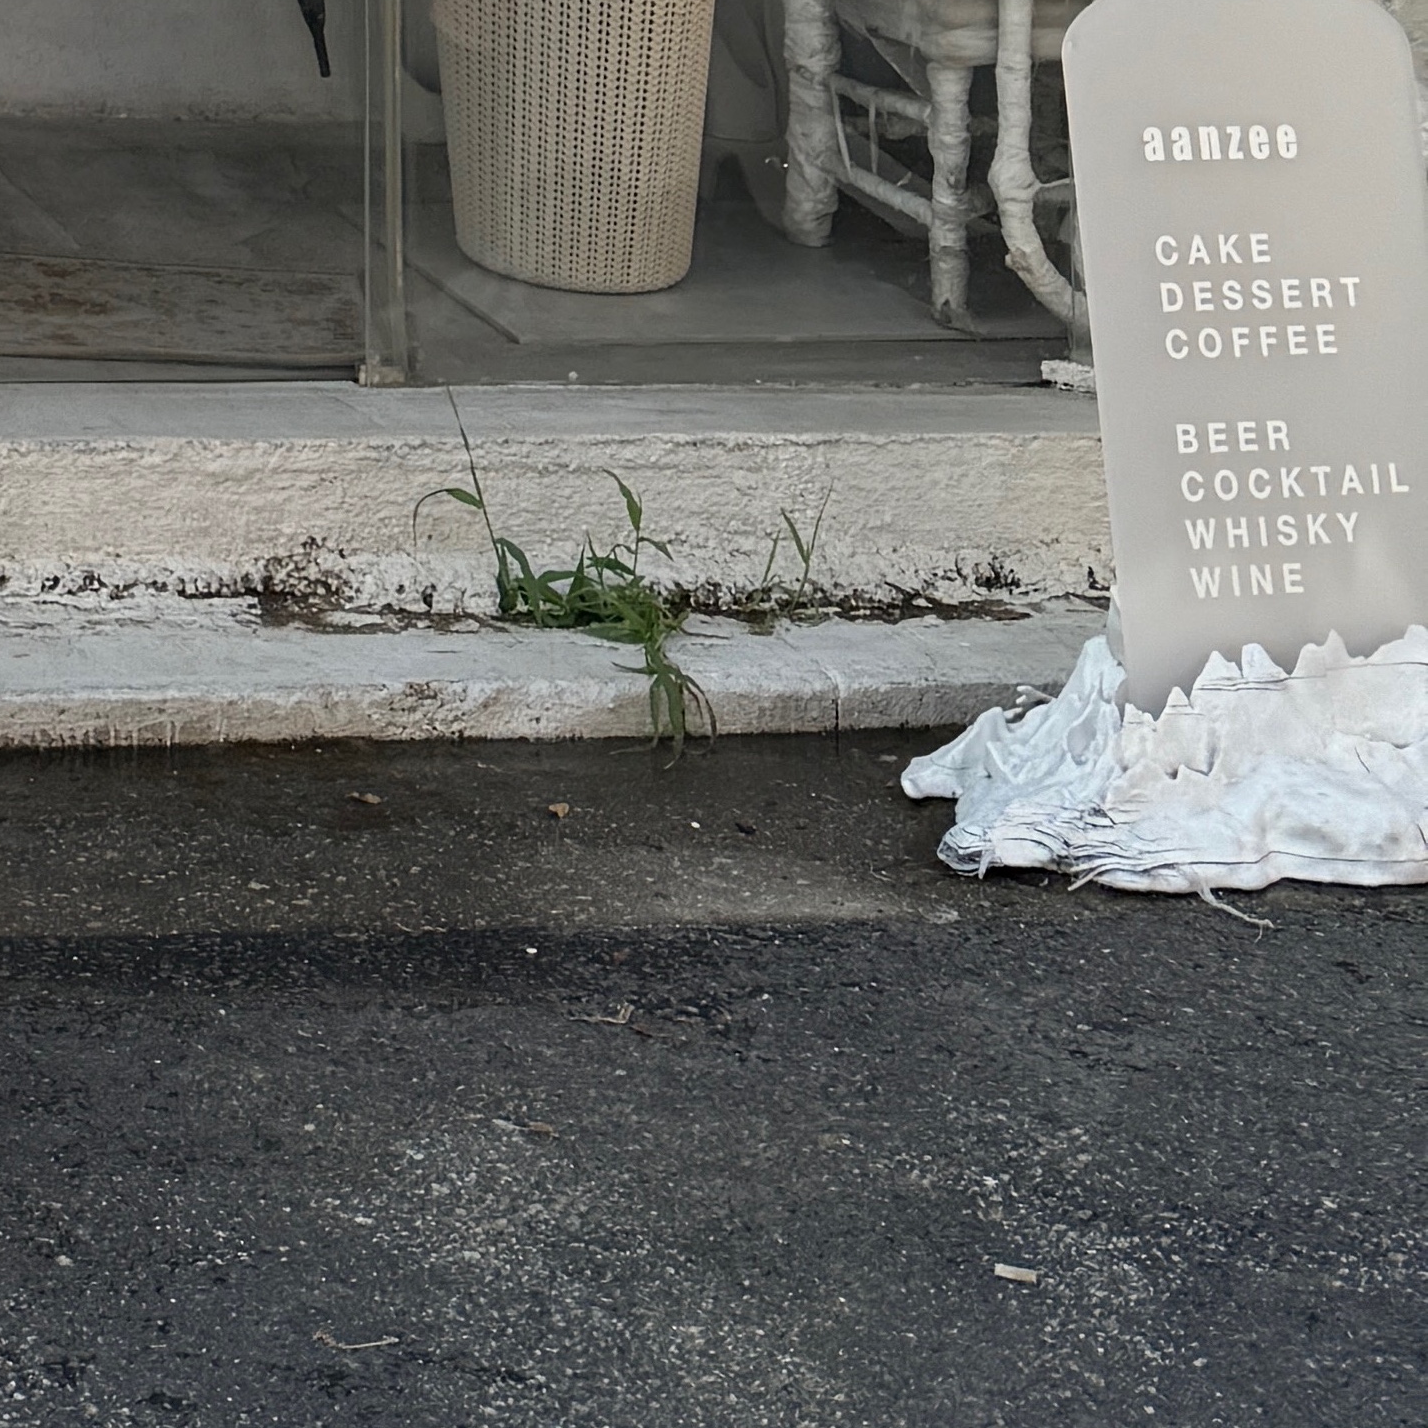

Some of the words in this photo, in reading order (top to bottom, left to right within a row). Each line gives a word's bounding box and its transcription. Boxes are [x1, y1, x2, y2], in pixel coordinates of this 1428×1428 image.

[1142, 122, 1298, 162] aanzee
[1154, 232, 1272, 266] CAKE
[1159, 275, 1361, 313] DESSERT
[1164, 323, 1339, 360] COFFEE
[1175, 420, 1291, 455] BEER
[1180, 462, 1410, 503] COCKTAIL
[1184, 511, 1360, 551] WHISKY
[1189, 562, 1306, 599] WINE
